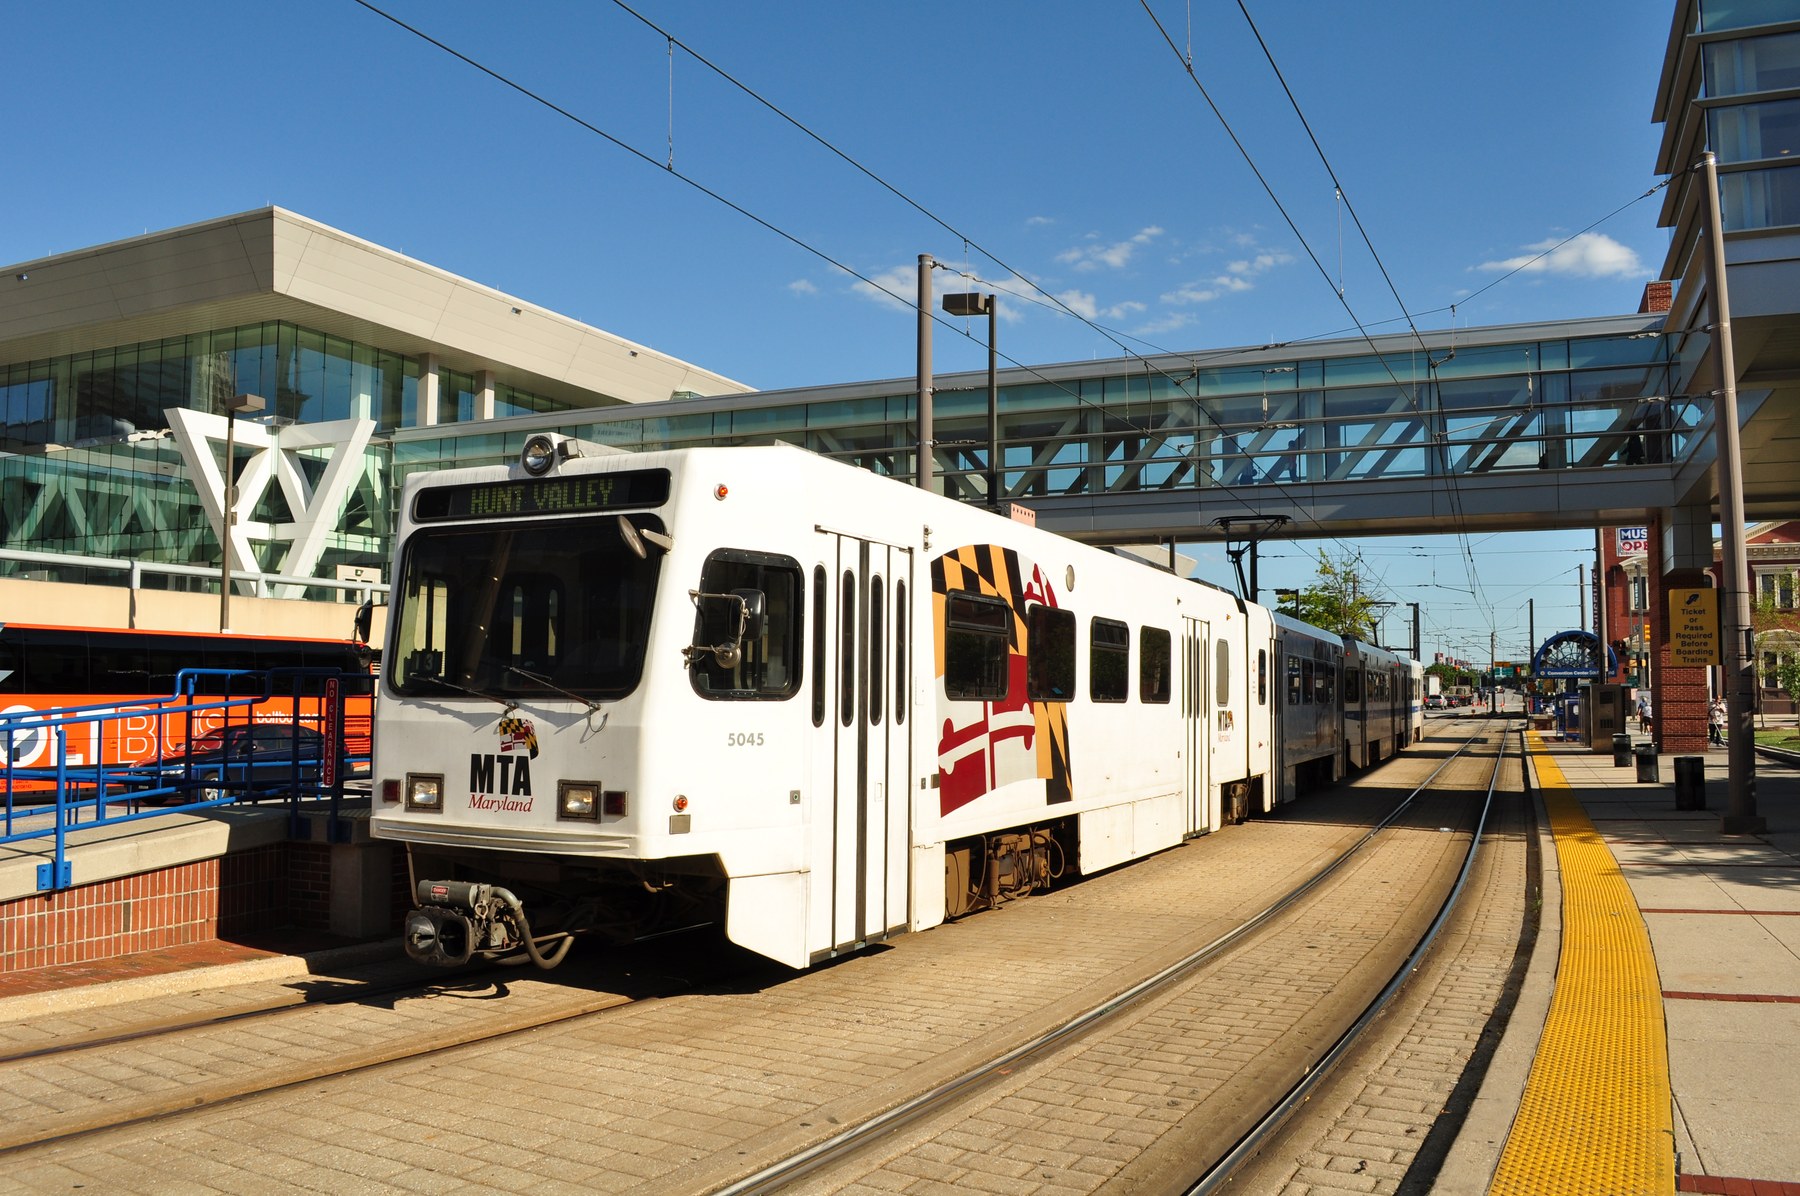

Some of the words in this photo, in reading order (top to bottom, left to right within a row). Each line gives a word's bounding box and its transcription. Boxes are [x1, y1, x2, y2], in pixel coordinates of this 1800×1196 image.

[470, 485, 525, 514] HUNT
[534, 479, 613, 510] VALLEY
[329, 681, 336, 698] NO
[326, 704, 335, 784] CLEARANCE
[727, 732, 764, 747] 5045
[470, 753, 532, 796] MTA
[468, 794, 534, 813] Maryland
